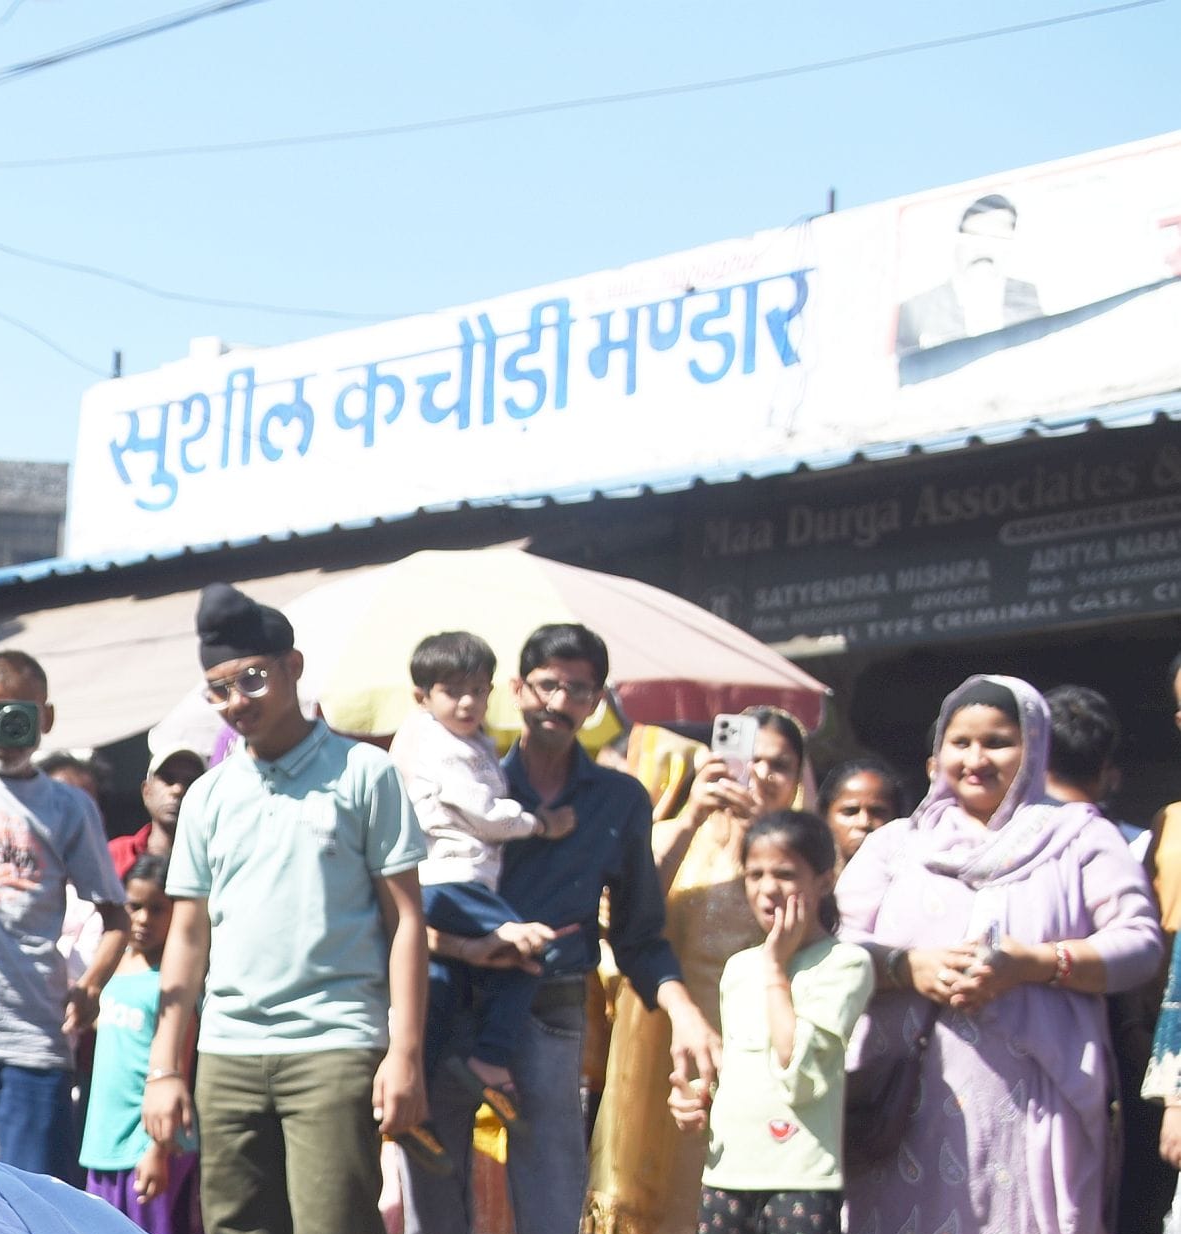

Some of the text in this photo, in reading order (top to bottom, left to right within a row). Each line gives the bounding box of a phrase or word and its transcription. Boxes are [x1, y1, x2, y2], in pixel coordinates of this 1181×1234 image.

[110, 268, 817, 512] सुशील कचौड़ी भण्डार
[703, 519, 774, 556] Maa
[786, 500, 902, 548] Durga
[912, 461, 1136, 527] Associates
[1028, 538, 1111, 573] ADITYA
[754, 558, 991, 609] SATYENDRA MISHRA
[868, 613, 925, 638] TYPE
[932, 597, 1060, 632] CRIMINAL
